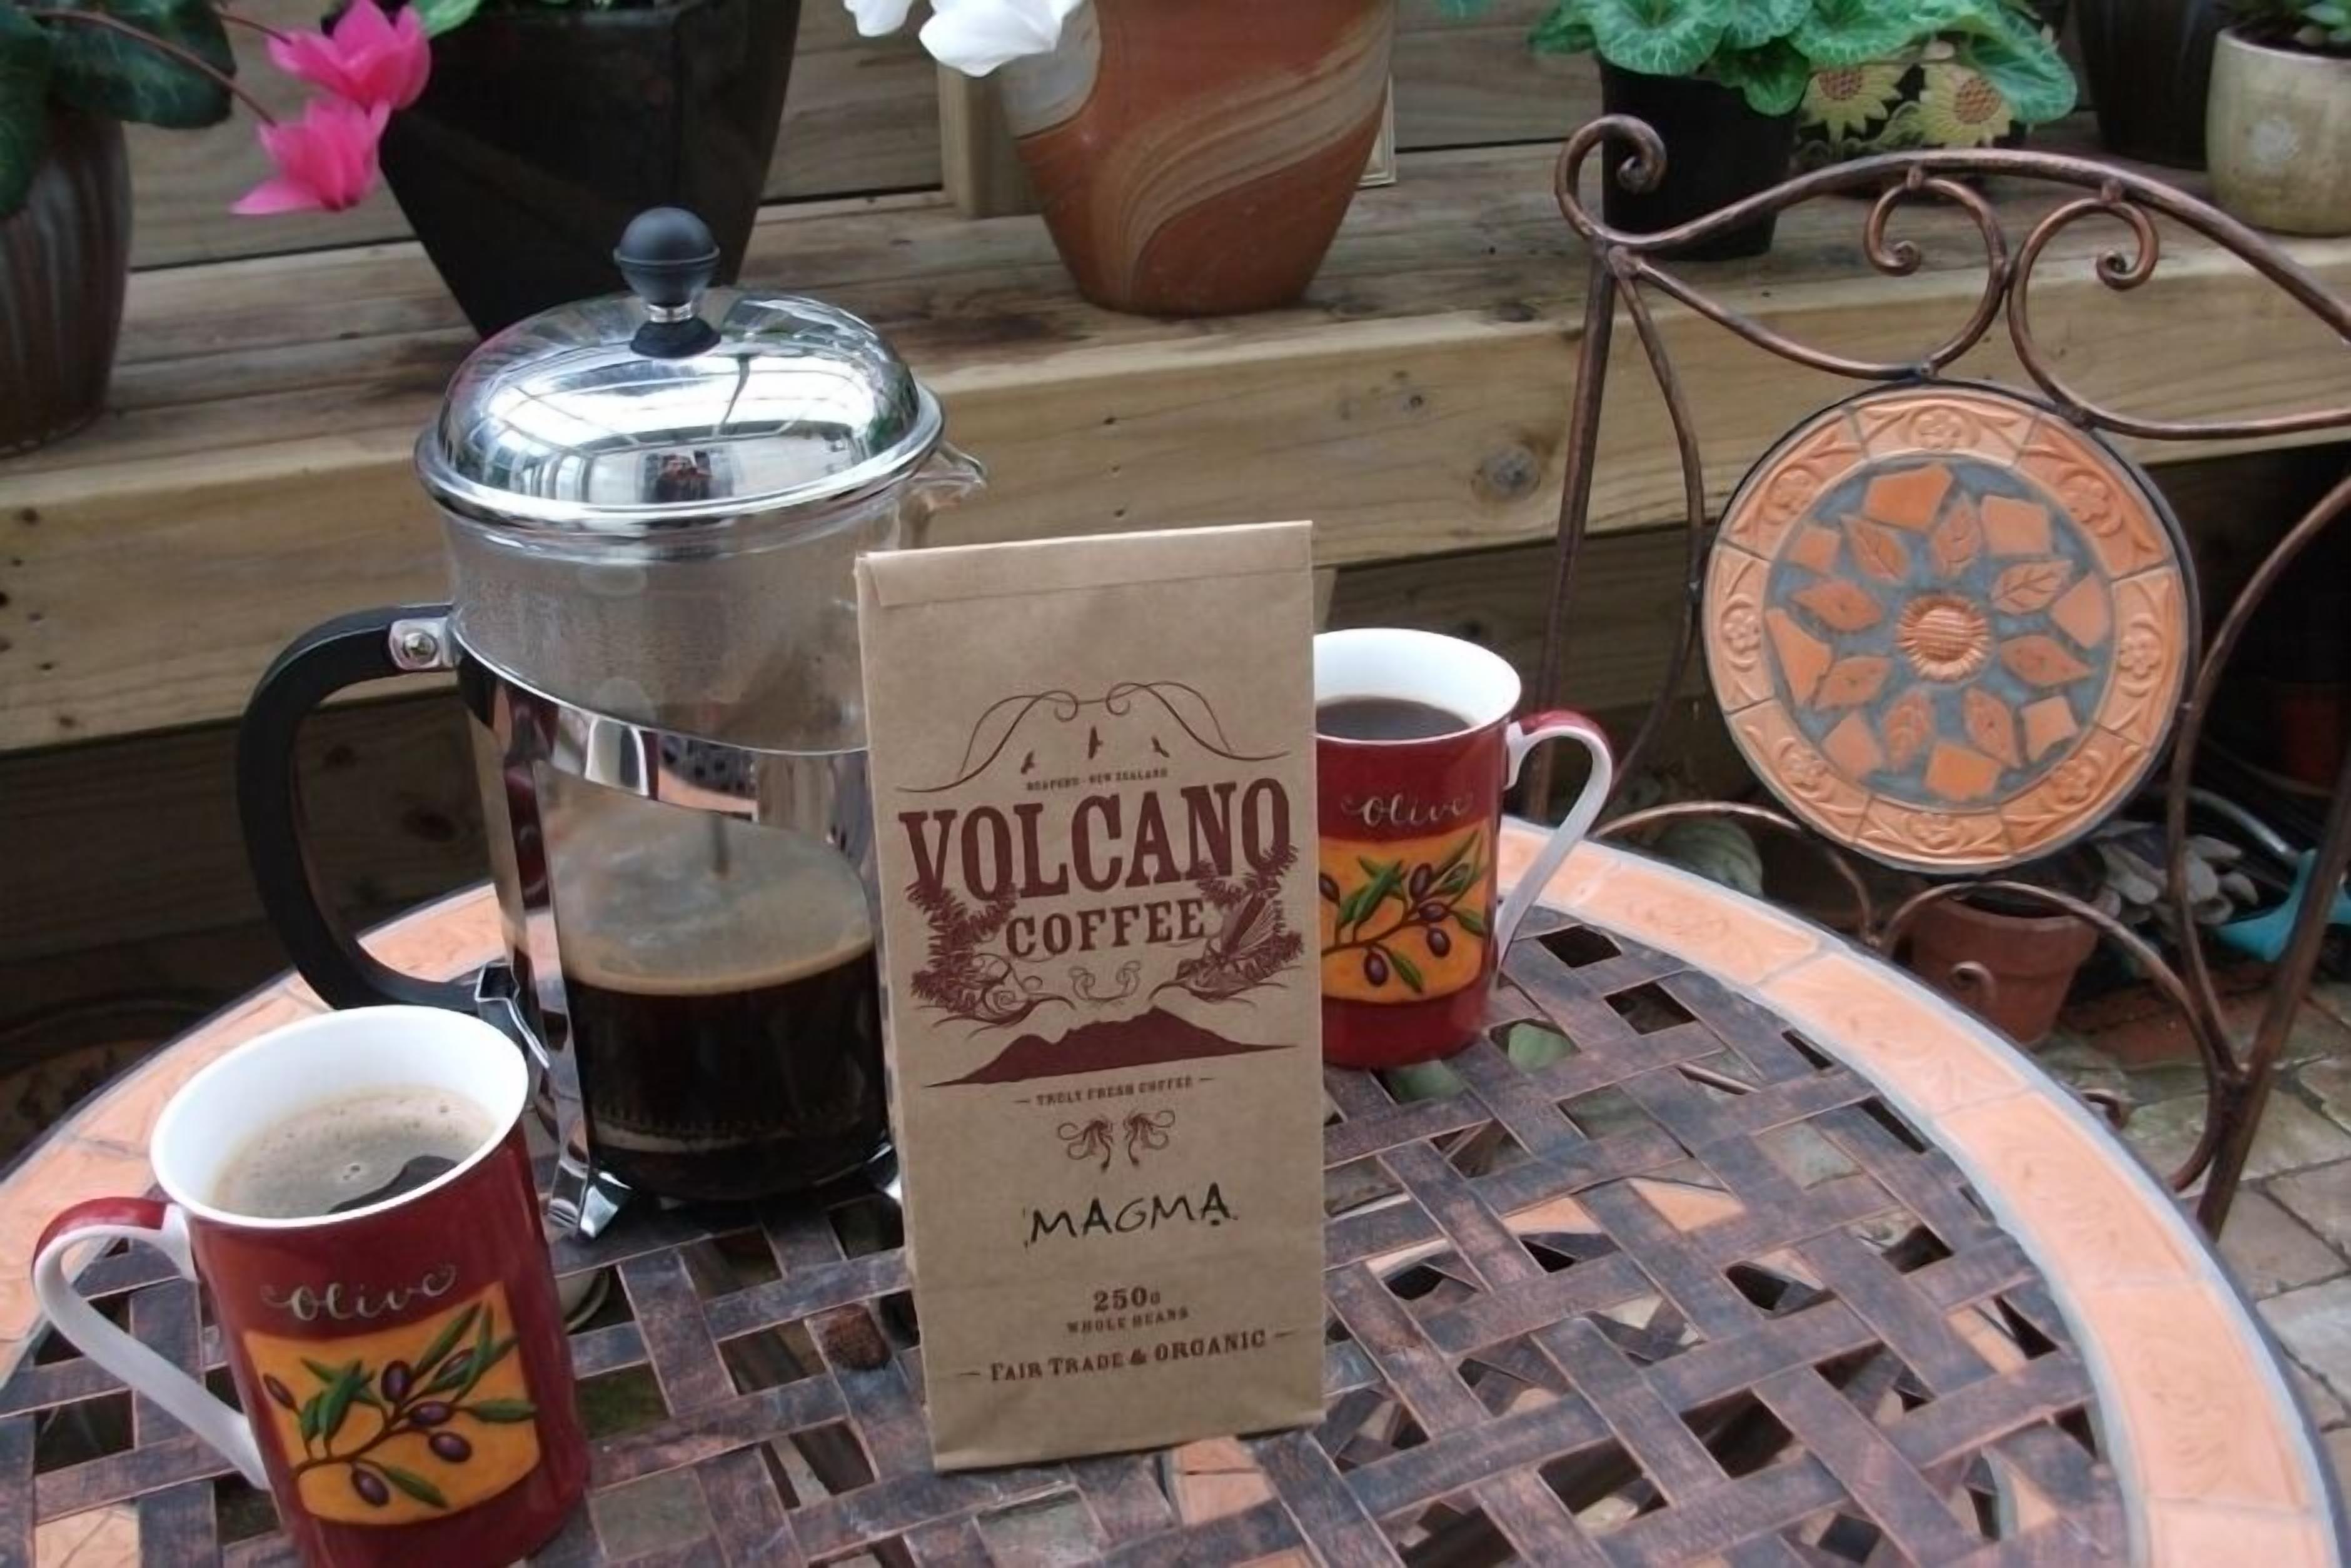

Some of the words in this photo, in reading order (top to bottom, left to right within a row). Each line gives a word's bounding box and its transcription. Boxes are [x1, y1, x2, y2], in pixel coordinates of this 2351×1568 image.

[898, 778, 1291, 902] VOLCANO
[1005, 898, 1204, 958] COFFEE
[1139, 1075, 1191, 1093] COFFEE
[1030, 1182, 1232, 1245] MAGMA
[1067, 1317, 1126, 1334] WHOLE
[1132, 1305, 1188, 1329] BEANS
[1129, 1348, 1147, 1365] &
[1155, 1329, 1266, 1360] ORGANIC
